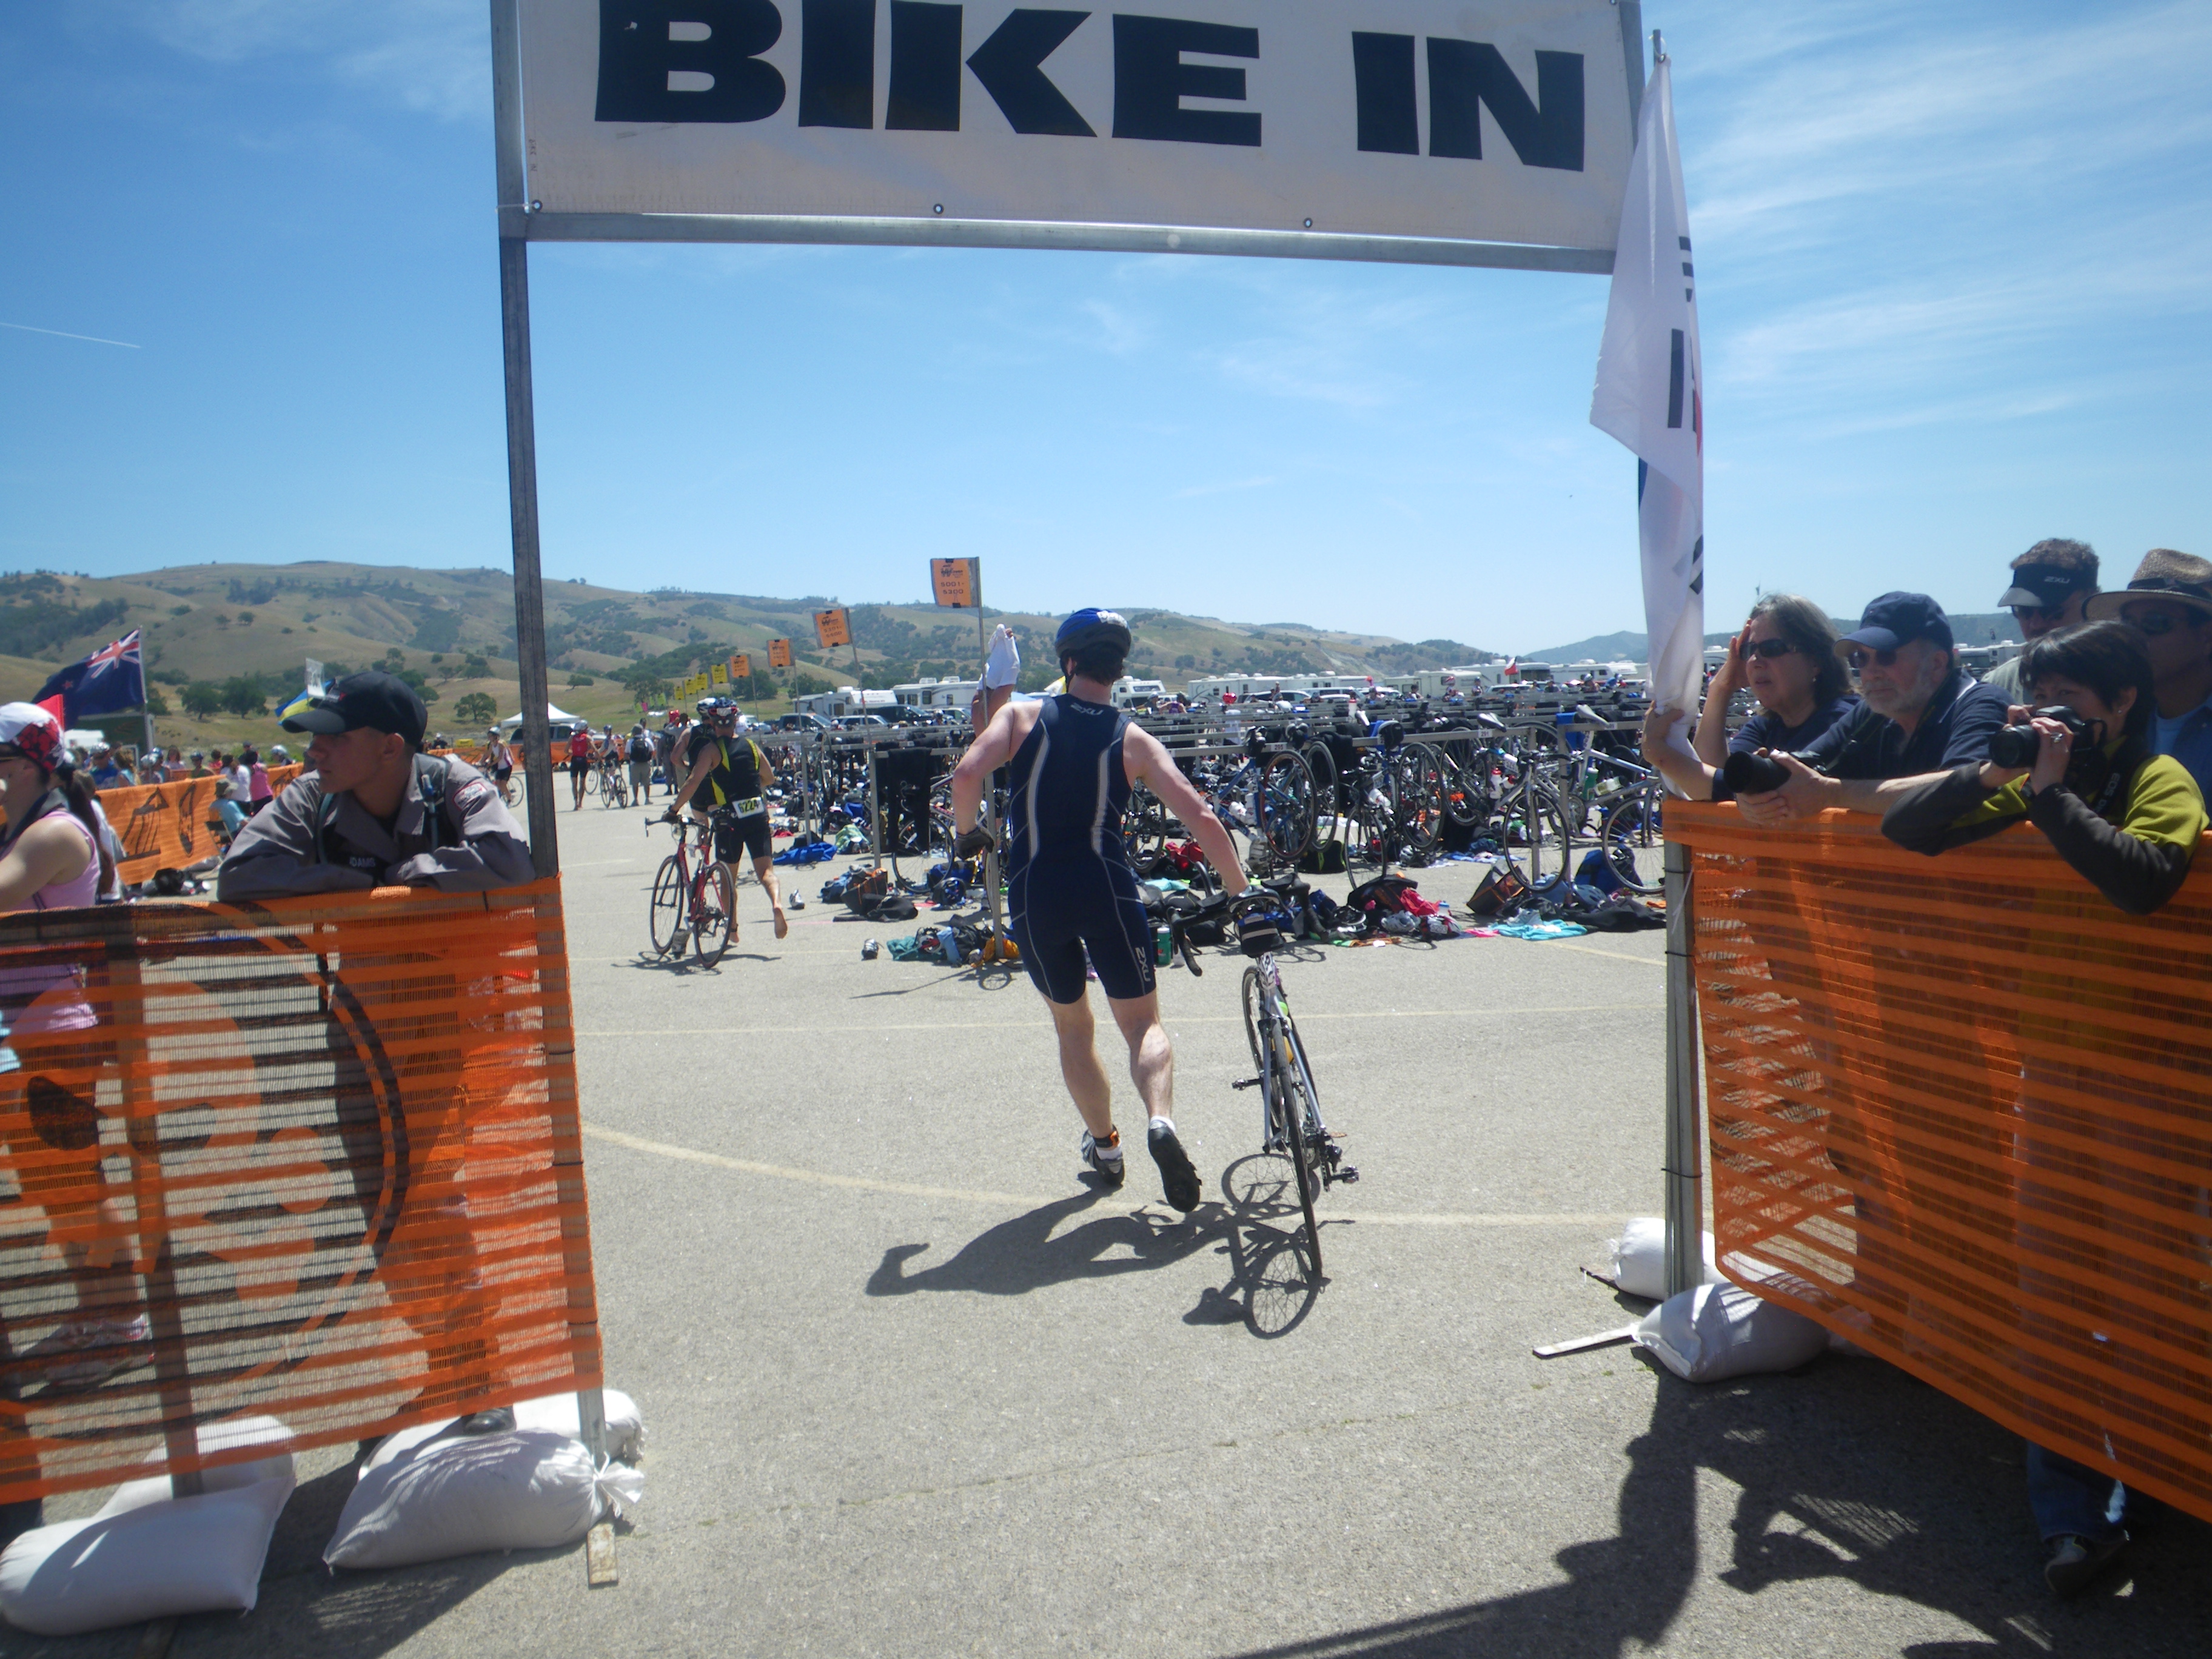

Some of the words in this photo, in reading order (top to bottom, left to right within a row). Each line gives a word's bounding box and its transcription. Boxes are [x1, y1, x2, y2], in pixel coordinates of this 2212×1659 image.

[595, 0, 1262, 147] BIKE
[1352, 31, 1584, 172] IN
[1070, 703, 1104, 716] 2XU
[1134, 947, 1151, 982] 2XU
